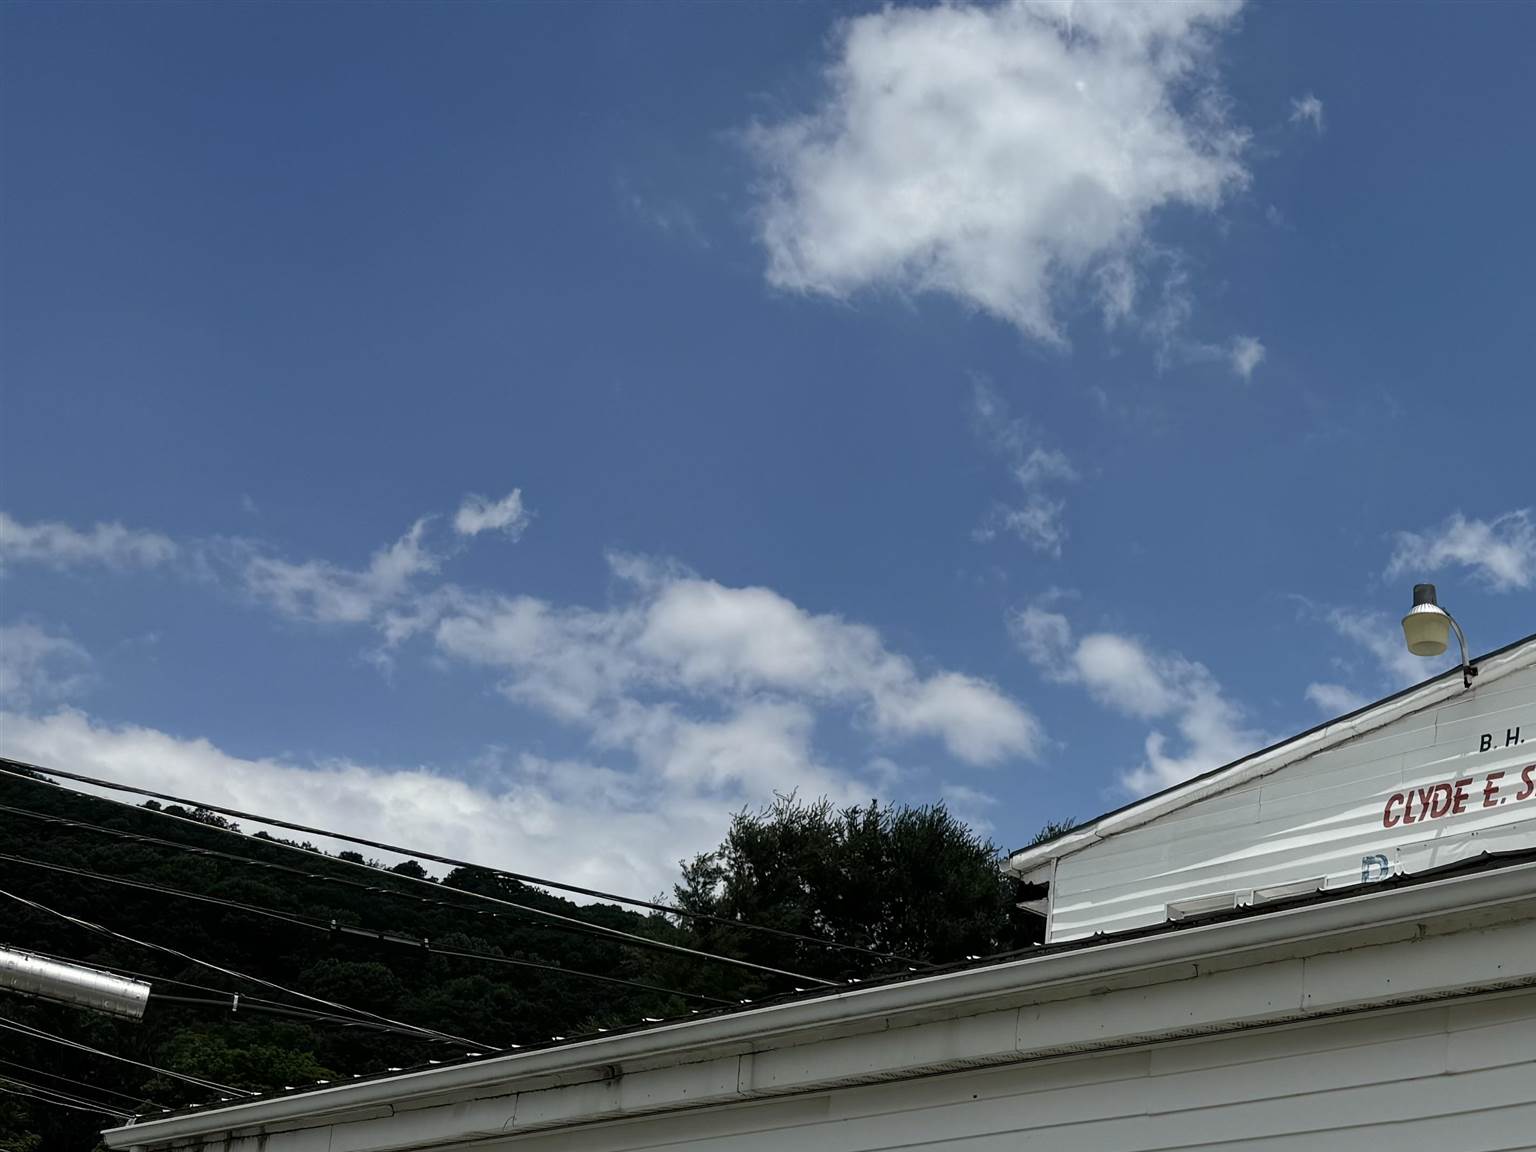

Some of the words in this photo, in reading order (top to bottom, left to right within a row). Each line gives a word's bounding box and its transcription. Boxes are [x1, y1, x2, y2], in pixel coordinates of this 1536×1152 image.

[1479, 733, 1498, 753] B.
[1505, 726, 1525, 746] H.
[1383, 777, 1473, 828] CLYDE
[1482, 771, 1506, 808] E.
